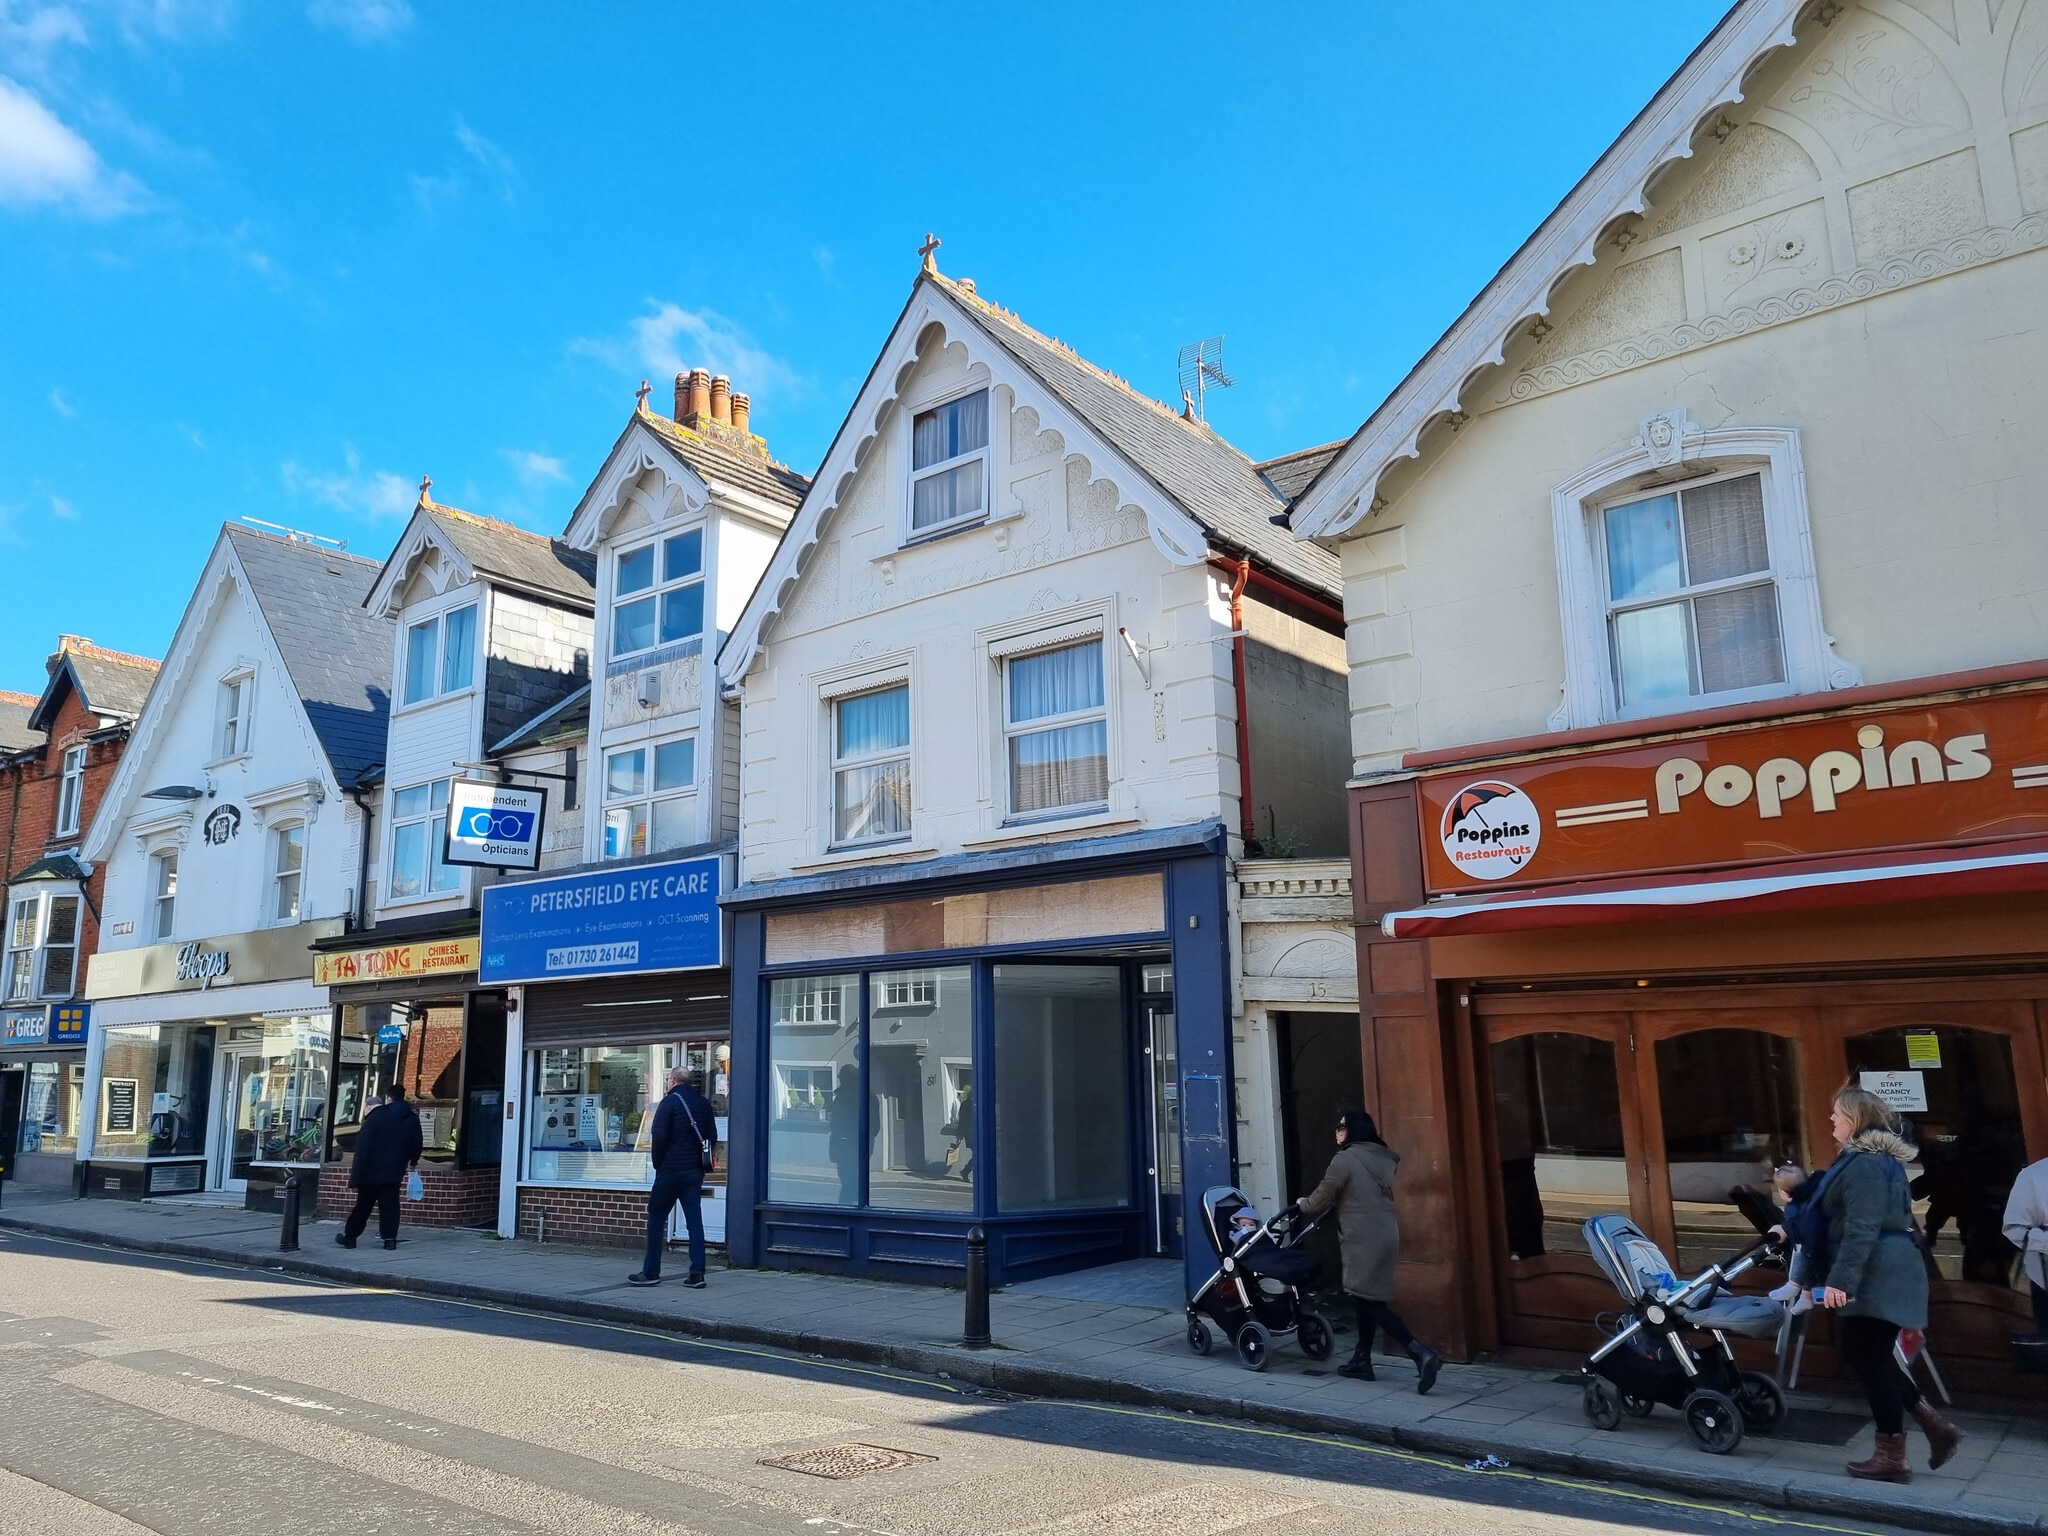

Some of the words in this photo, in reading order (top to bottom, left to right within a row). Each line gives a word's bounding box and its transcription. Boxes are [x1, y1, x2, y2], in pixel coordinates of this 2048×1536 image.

[1655, 724, 1992, 819] Poppins
[1457, 821, 1530, 844] Poppins
[481, 843, 529, 856] Opticians
[1455, 845, 1532, 861] Restaurants
[530, 883, 626, 913] PETERSFIELD
[630, 878, 659, 901] EYE
[663, 872, 709, 897] CARE
[585, 923, 597, 933] Eye
[598, 920, 643, 932] Examinations
[657, 914, 675, 926] OCT
[676, 911, 709, 924] Scanning
[428, 944, 459, 957] CHINESE
[548, 951, 565, 967] Tel:
[567, 948, 597, 965] 01730
[598, 945, 637, 962] 261442
[175, 941, 231, 991] Hoops
[334, 953, 361, 978] TAI
[364, 947, 411, 974] TONG
[422, 954, 470, 969] RESTAURANT
[487, 953, 506, 967] NHS
[1308, 982, 1327, 998] 15
